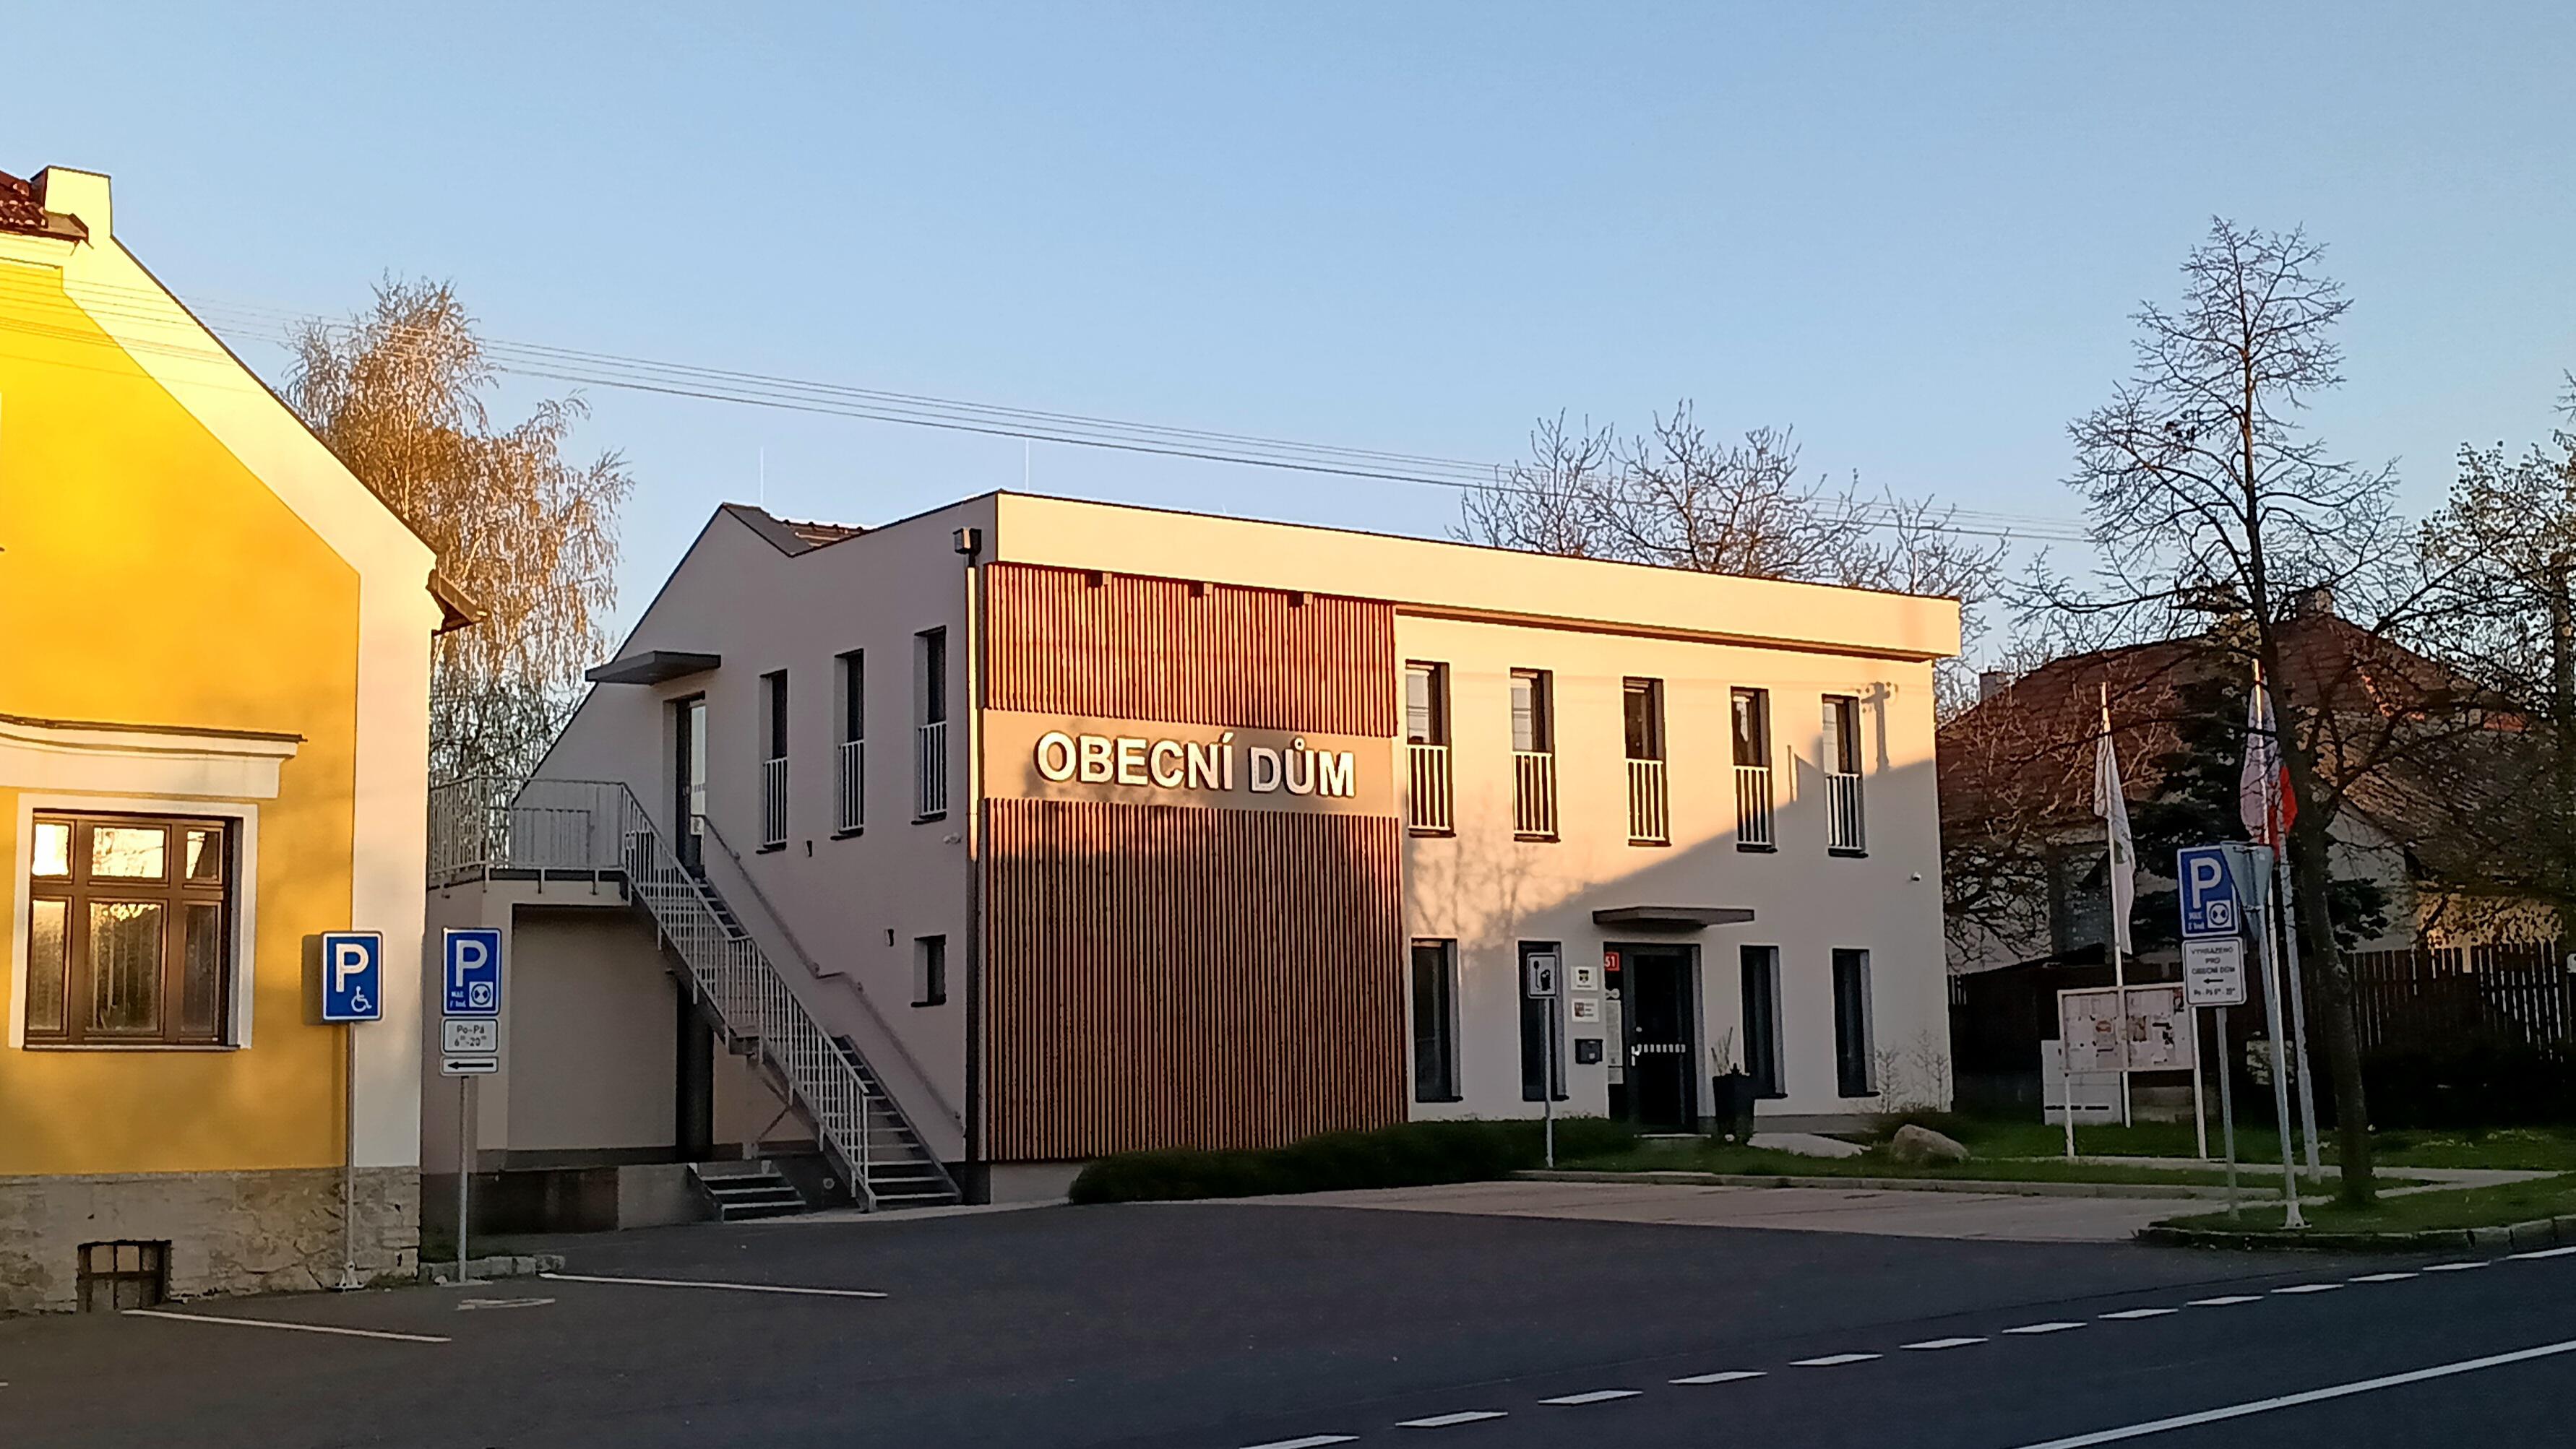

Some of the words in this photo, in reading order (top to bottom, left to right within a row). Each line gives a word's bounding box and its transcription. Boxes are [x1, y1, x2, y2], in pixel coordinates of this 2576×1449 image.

[1036, 730, 1233, 790] OBECNÍ
[1249, 736, 1356, 797] DŮM
[2189, 857, 2222, 909] P
[335, 943, 369, 992] P
[456, 940, 488, 987] P
